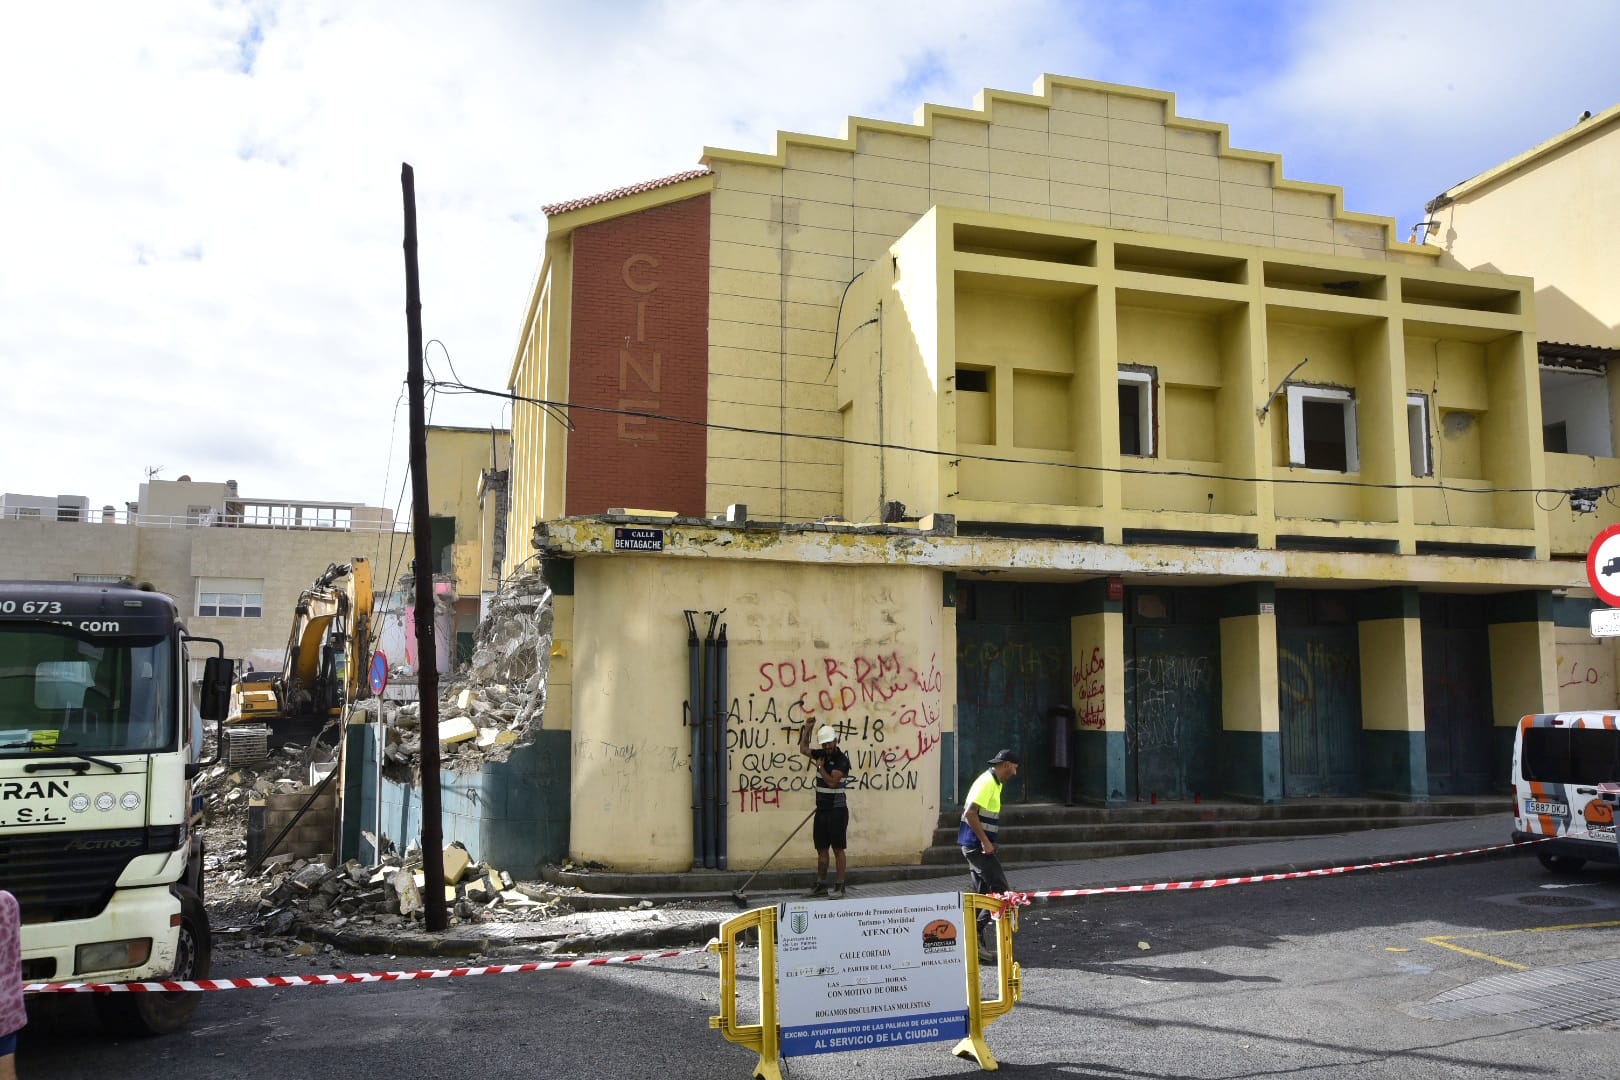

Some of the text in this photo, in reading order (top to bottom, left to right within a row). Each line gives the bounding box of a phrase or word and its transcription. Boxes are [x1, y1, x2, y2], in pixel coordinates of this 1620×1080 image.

[617, 253, 661, 441] CINE
[615, 539, 662, 550] BENTAGACHE
[23, 602, 62, 613] 673
[861, 926, 910, 937] ATENCIÓN
[840, 949, 891, 960] CALLE CORTADA
[827, 990, 842, 999] CON
[844, 988, 872, 997] MOTIVO
[885, 985, 908, 993] OBRAS
[815, 1000, 931, 1018] ROGAMOS DISCULPEN LAS MOLESTIAS
[810, 1026, 861, 1037] AYUNTAMIENTO
[872, 1023, 884, 1031] LAS
[885, 1021, 910, 1030] PALMAS
[911, 1019, 919, 1027] DE
[920, 1018, 938, 1026] GRAN
[814, 1028, 939, 1049] AL SERVICIO DE LA CIUDAD
